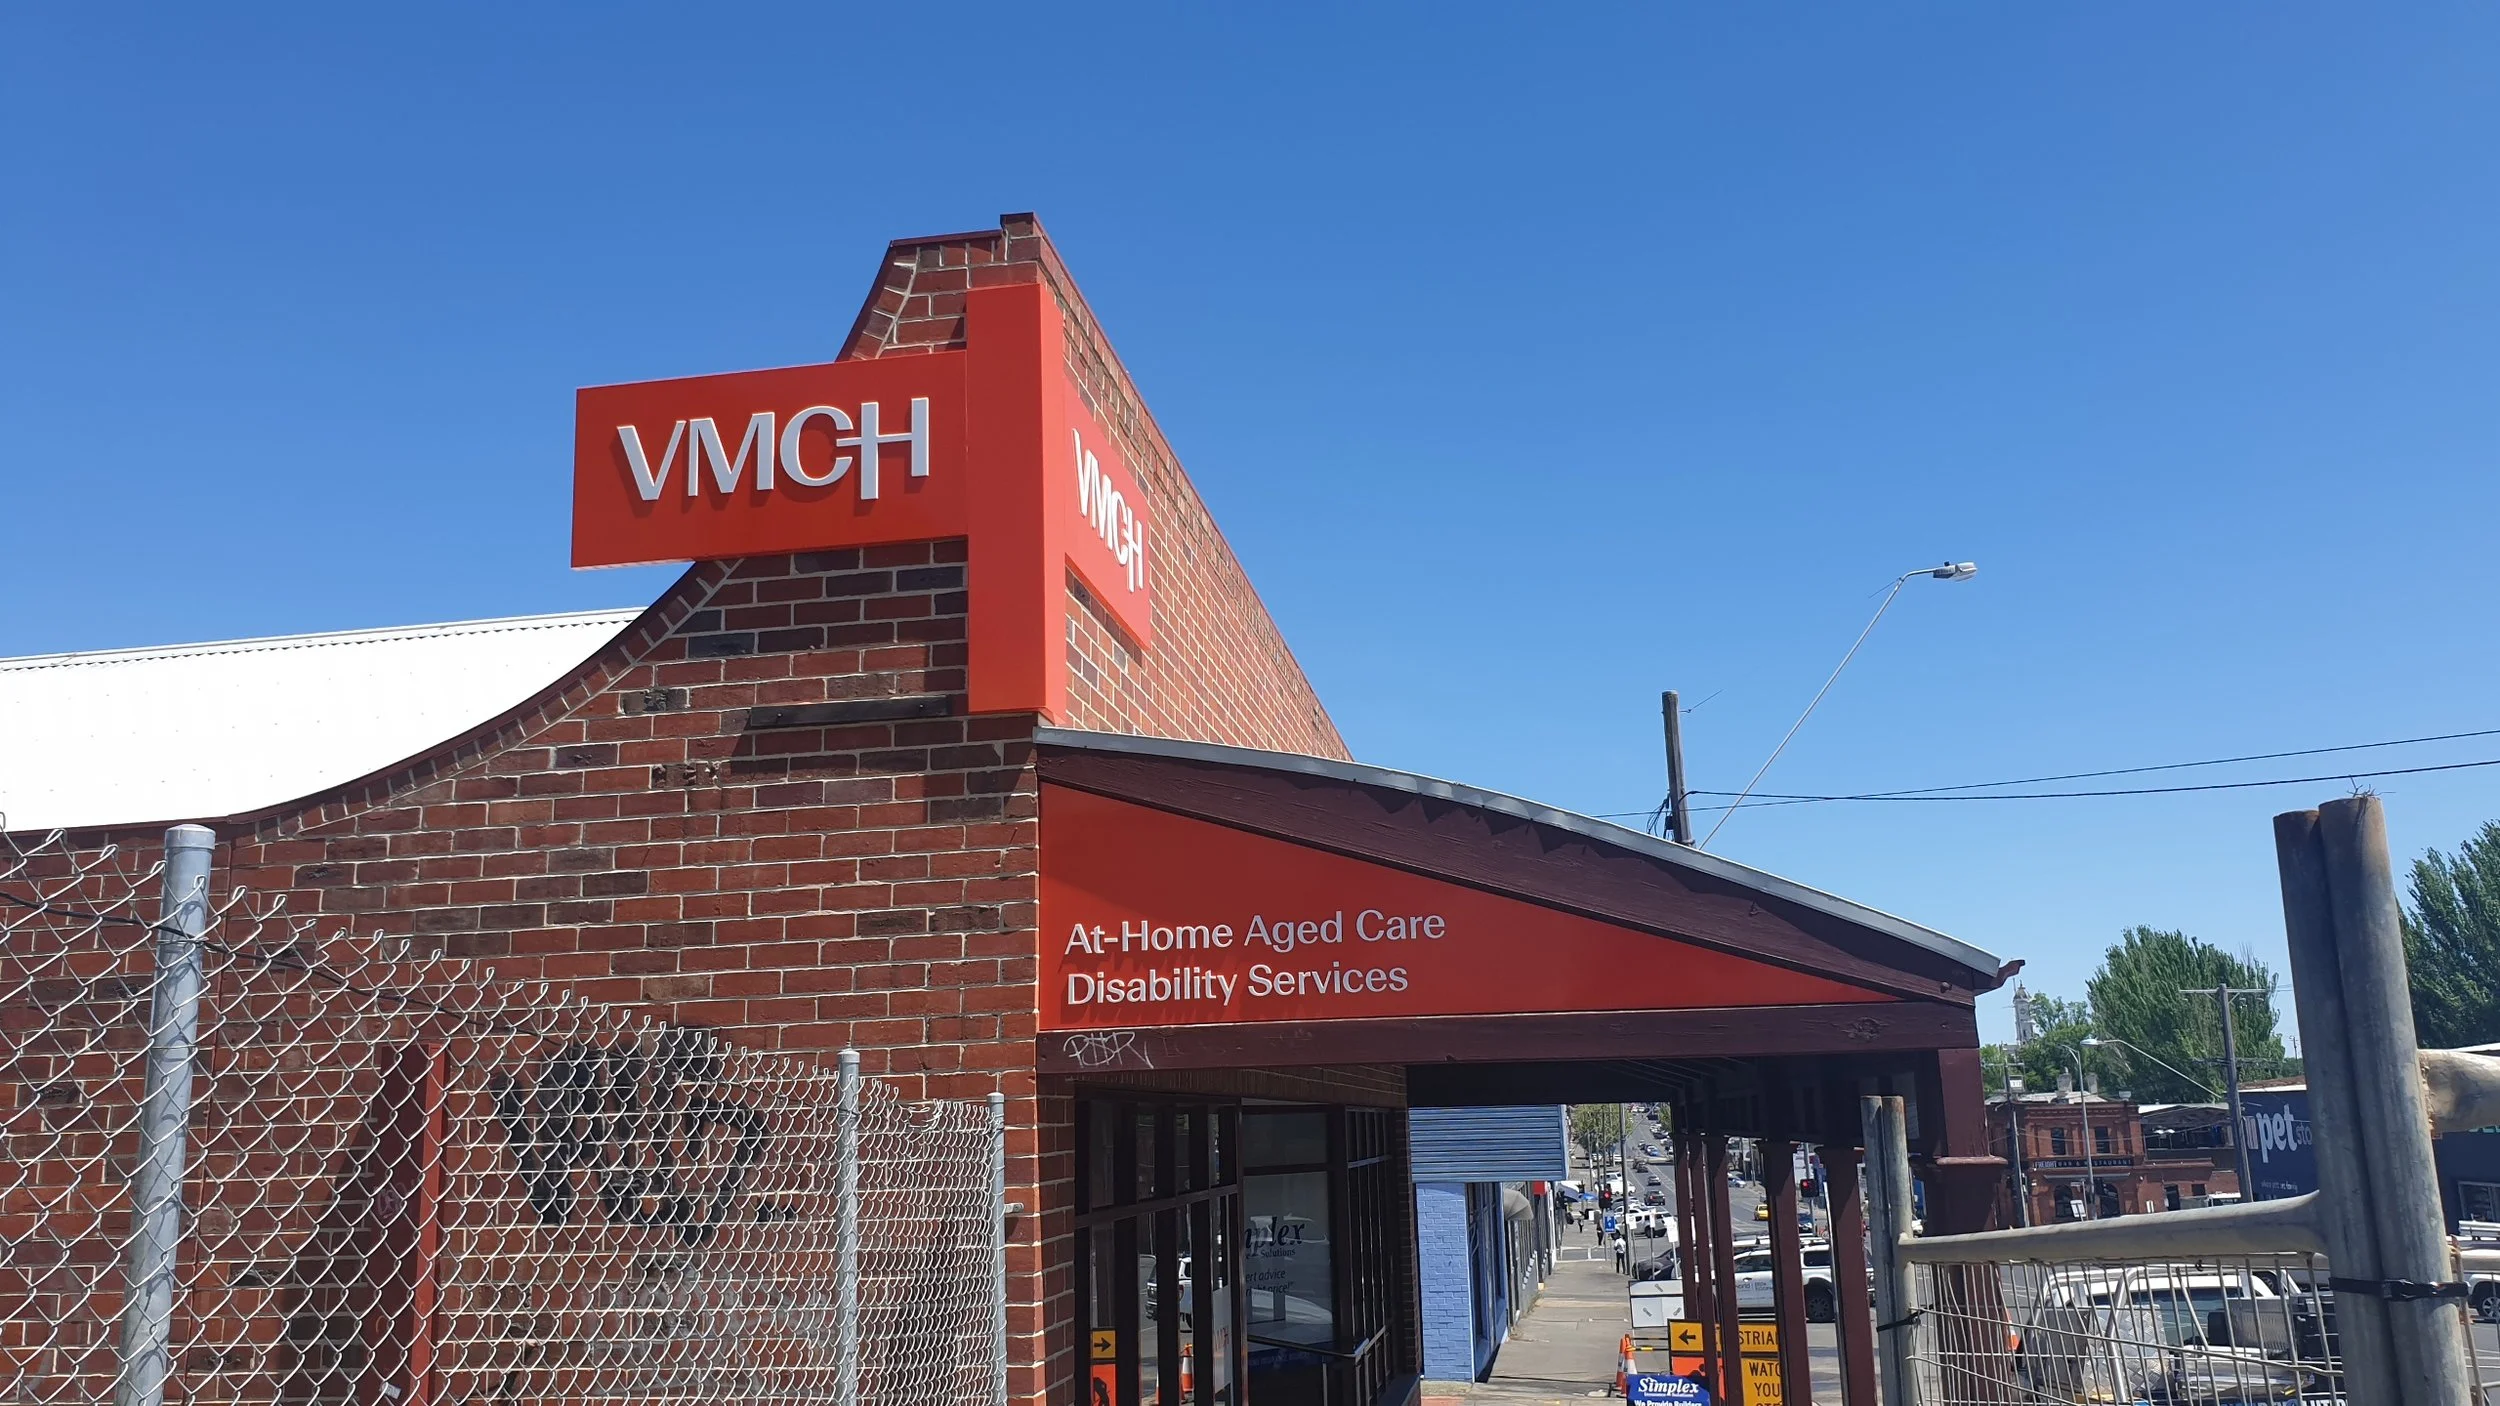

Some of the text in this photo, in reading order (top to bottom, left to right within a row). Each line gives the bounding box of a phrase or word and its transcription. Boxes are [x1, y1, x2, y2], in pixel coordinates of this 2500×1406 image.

[616, 397, 930, 501] VMCH
[1072, 427, 1144, 593] VMCH
[1064, 909, 1446, 955] At-Home Aged Care
[1067, 961, 1409, 1006] Disability Services
[1260, 1247, 1296, 1258] Solutions
[1258, 1267, 1286, 1281] advice
[1749, 1362, 1780, 1377] WATC
[1638, 1376, 1699, 1396] Simplex
[1754, 1382, 1780, 1397] YOU
